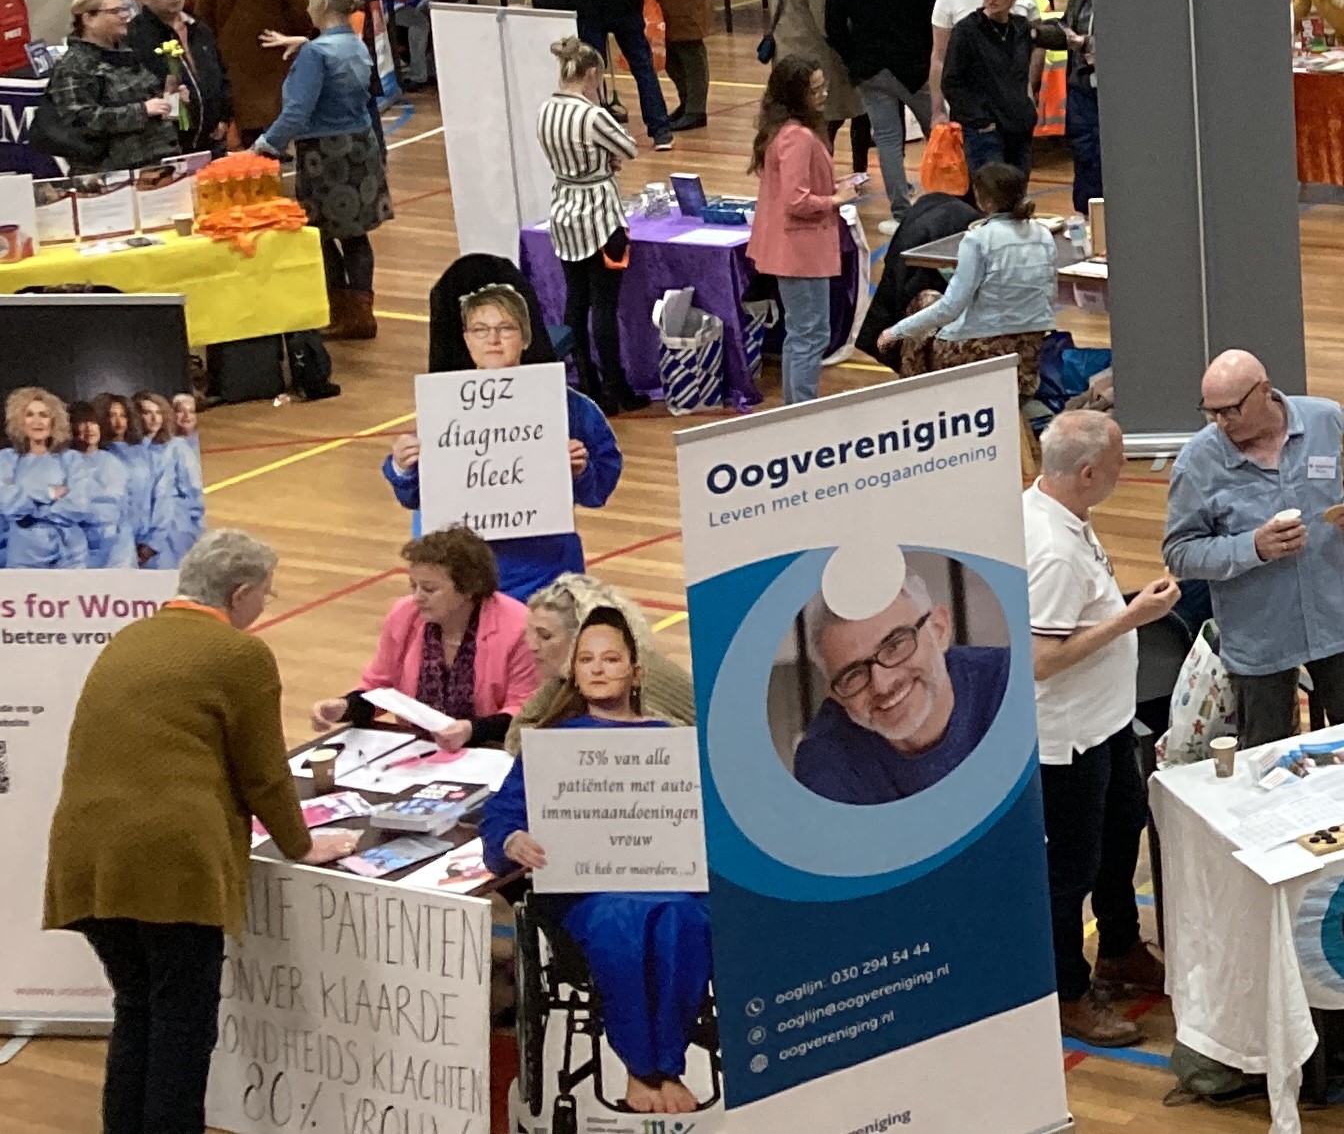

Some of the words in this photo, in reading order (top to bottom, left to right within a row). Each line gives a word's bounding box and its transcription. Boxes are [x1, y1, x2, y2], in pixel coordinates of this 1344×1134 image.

[460, 377, 514, 410] GGZ
[438, 420, 544, 456] diagnose
[706, 406, 995, 495] Oogvereniging
[466, 457, 525, 489] bleek
[709, 501, 766, 528] Leven
[772, 490, 809, 513] met
[815, 482, 849, 500] een
[855, 444, 997, 490] oogaandoening
[462, 508, 537, 532] tumor
[25, 593, 70, 618] for
[2, 628, 67, 644] betere
[578, 750, 609, 766] 75%
[614, 754, 640, 765] van
[645, 747, 671, 765] alle
[552, 778, 625, 800] patiënten
[631, 779, 656, 792] met
[661, 779, 700, 792] auto-
[542, 801, 699, 827] immuunaandoeningen
[610, 834, 653, 846] vrouw
[595, 860, 612, 875] heb
[615, 866, 626, 875] er
[247, 876, 293, 942] LLE
[831, 966, 859, 985] 030
[862, 956, 888, 975] 294
[892, 948, 909, 965] 54
[912, 942, 931, 956] 44
[320, 971, 459, 1047] KLAARDE
[777, 963, 950, 1033] ooglijn@oogvereniging.nl
[778, 1010, 895, 1060] oogvereniging.nl
[372, 1046, 484, 1114] KLACHTEN
